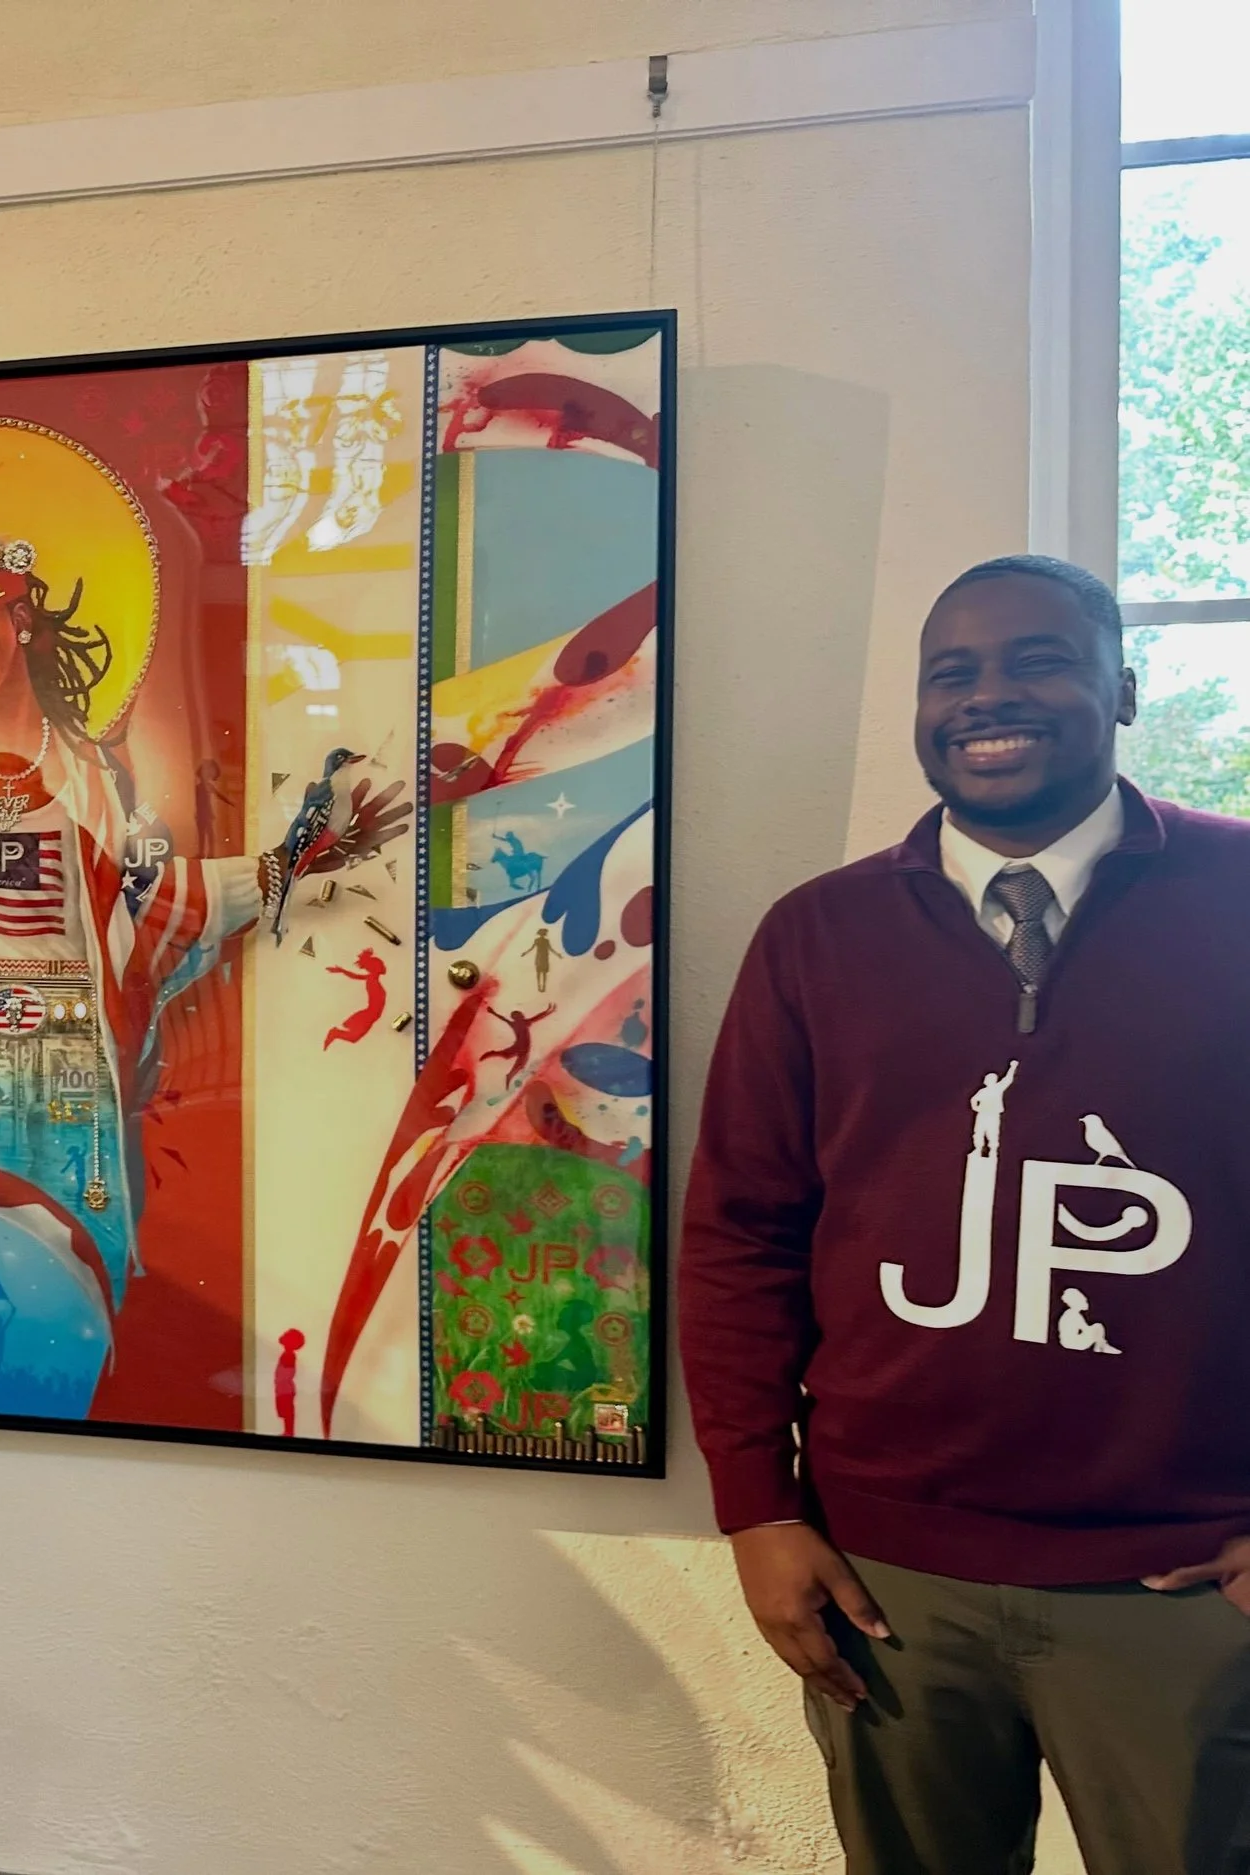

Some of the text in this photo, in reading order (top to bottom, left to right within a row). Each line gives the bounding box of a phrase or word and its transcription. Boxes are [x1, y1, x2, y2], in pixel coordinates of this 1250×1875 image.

[124, 838, 169, 868] JP
[59, 1070, 96, 1089] 100
[509, 1243, 579, 1285] JP
[879, 1152, 1193, 1345] JP
[500, 1391, 571, 1432] JP
